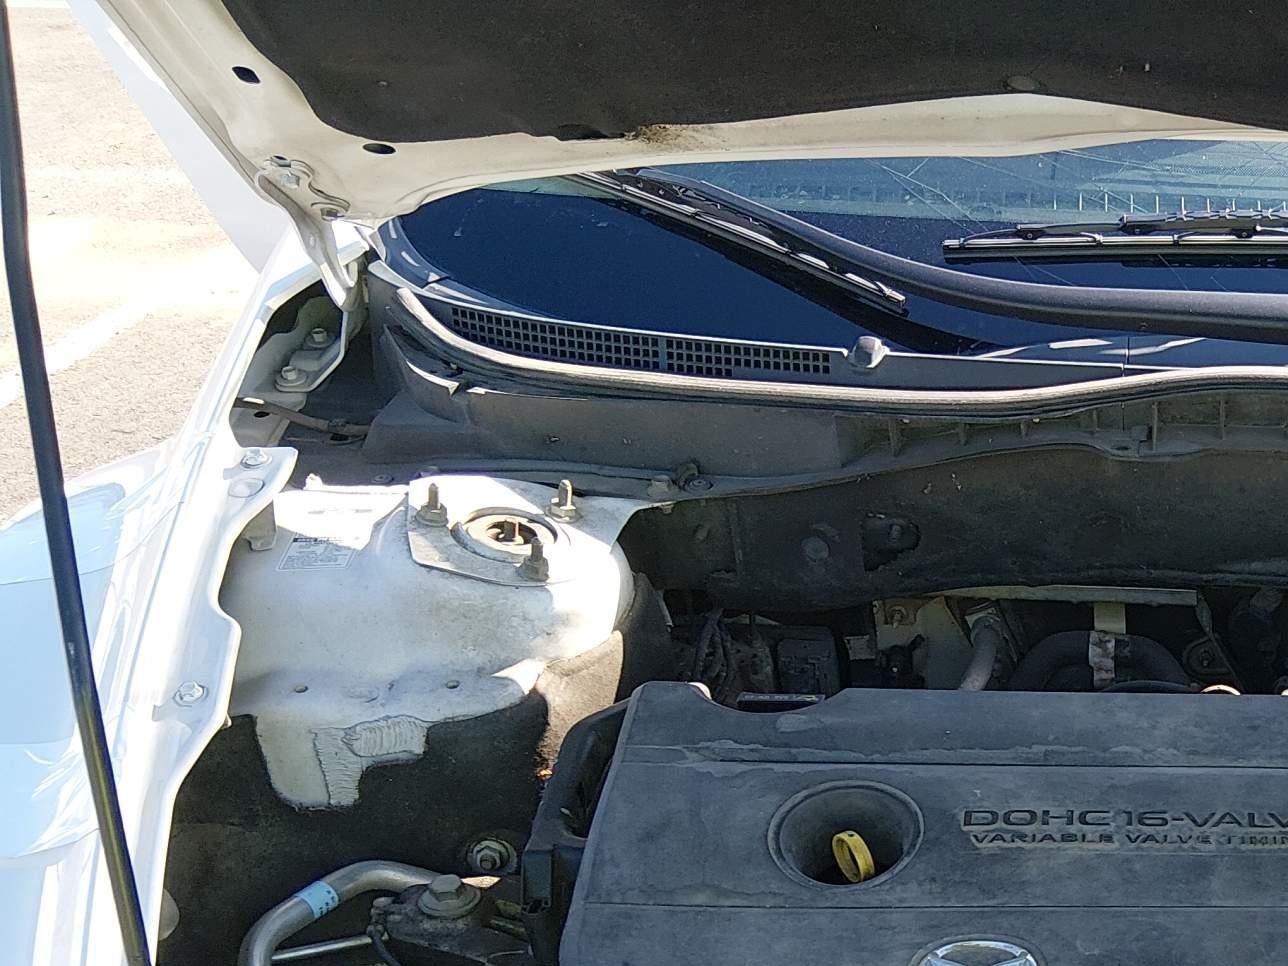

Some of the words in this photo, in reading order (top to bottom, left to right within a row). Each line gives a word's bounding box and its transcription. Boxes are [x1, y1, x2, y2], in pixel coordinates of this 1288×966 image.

[962, 809, 1111, 827] DOHC
[972, 833, 1115, 845] VARIABLE
[1125, 833, 1214, 845] VALVE
